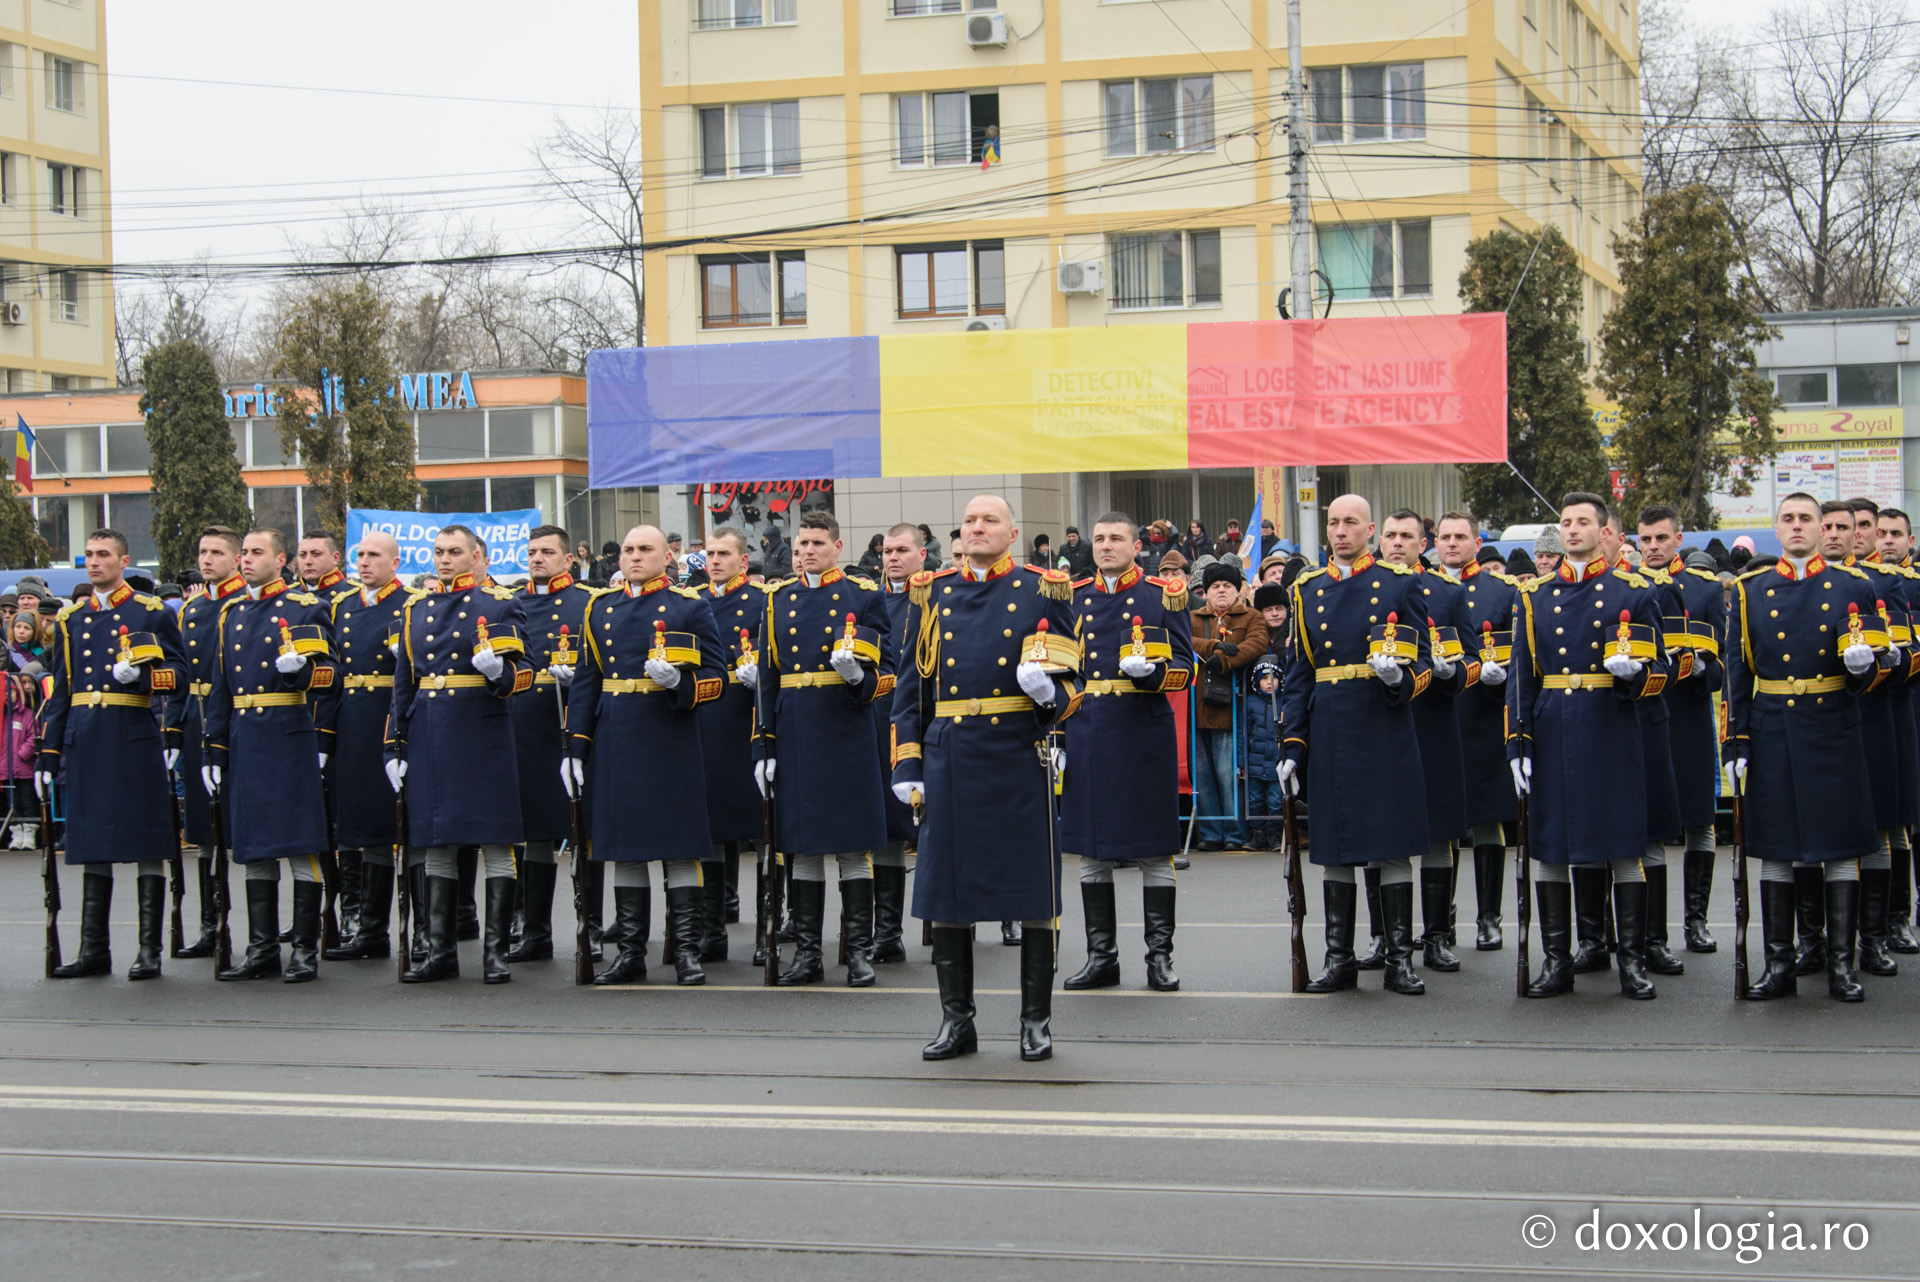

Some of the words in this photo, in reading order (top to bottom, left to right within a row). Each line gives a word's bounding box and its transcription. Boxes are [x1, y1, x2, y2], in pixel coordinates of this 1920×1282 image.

[1048, 369, 1153, 393] DETECTIVI
[1243, 365, 1352, 393] LOGEENT
[1361, 362, 1400, 389] IASI
[1405, 360, 1447, 387] UMF
[1036, 392, 1166, 418] PARTICULARI
[1172, 403, 1236, 431] REAL
[1243, 400, 1335, 428] ESTE
[1342, 395, 1447, 424] AGENCY
[1840, 441, 1865, 449] BILETE
[1866, 440, 1899, 448] AUTOCAR
[475, 523, 530, 544] VREA
